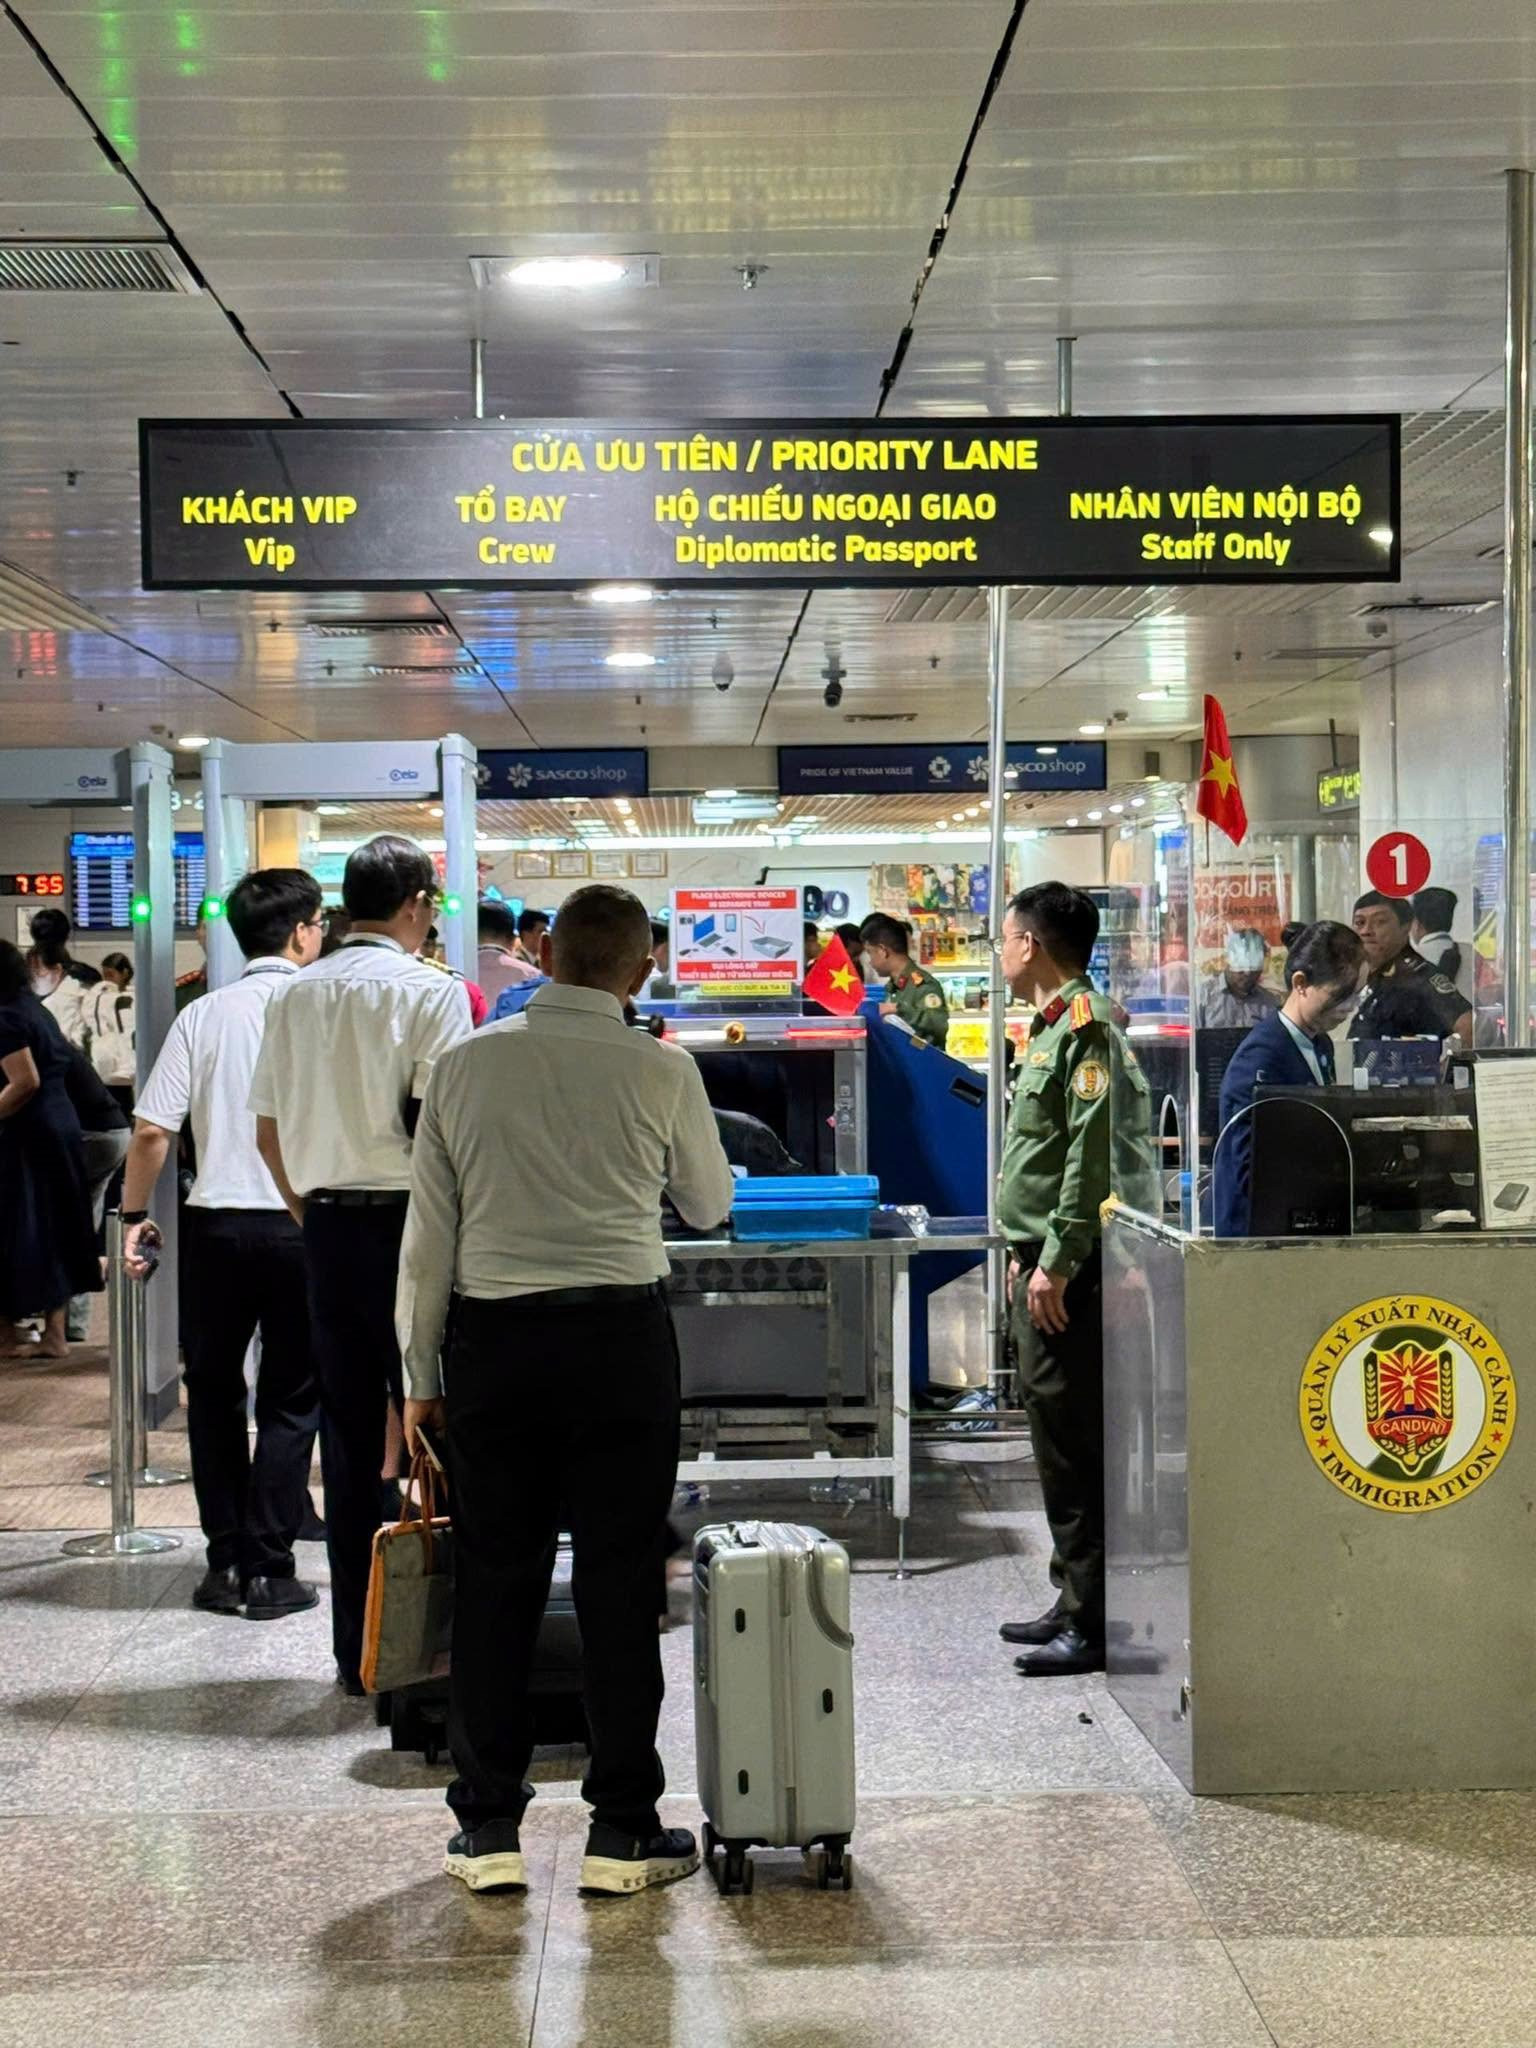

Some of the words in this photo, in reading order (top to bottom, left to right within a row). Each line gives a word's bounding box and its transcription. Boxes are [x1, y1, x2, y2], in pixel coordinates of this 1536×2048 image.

[511, 434, 584, 472] CỬA
[596, 441, 647, 472] ƯU
[655, 434, 738, 472] TIÊN
[746, 441, 763, 472] /
[771, 439, 934, 471] PRIORITY
[943, 439, 1038, 470] LANE
[182, 491, 294, 524] KHÁCH
[301, 496, 358, 525] VIP
[455, 484, 496, 524] TỔ
[504, 495, 567, 523] BAY
[655, 487, 701, 529] HỘ
[708, 484, 804, 523] CHIẾU
[811, 493, 912, 528] NGOẠI
[920, 492, 997, 521] GIAO
[1069, 485, 1161, 520] NHÂN
[1168, 484, 1245, 519] VIÊN
[1253, 484, 1309, 526] NỘI
[1318, 484, 1362, 525] BỘ
[244, 537, 297, 572] Vip
[478, 537, 555, 564] Crew
[675, 534, 837, 569] Diplomatic
[844, 534, 978, 569] Passport
[1141, 531, 1217, 561] Staff
[1223, 532, 1292, 567] Only
[536, 770, 588, 781] SASCO
[590, 765, 627, 783] shop
[1005, 762, 1047, 773] ASCO
[1049, 758, 1086, 775] shop
[1389, 843, 1408, 886] 1
[1303, 1362, 1331, 1432] QUẢN
[1325, 1324, 1353, 1359] LÝ
[1353, 1298, 1420, 1333] XUẤT
[1426, 1306, 1488, 1351] NHẬP
[1484, 1356, 1511, 1425] CẢNH
[1380, 1419, 1442, 1435] CANDVN
[1320, 1445, 1498, 1507] IMMIGRATION
